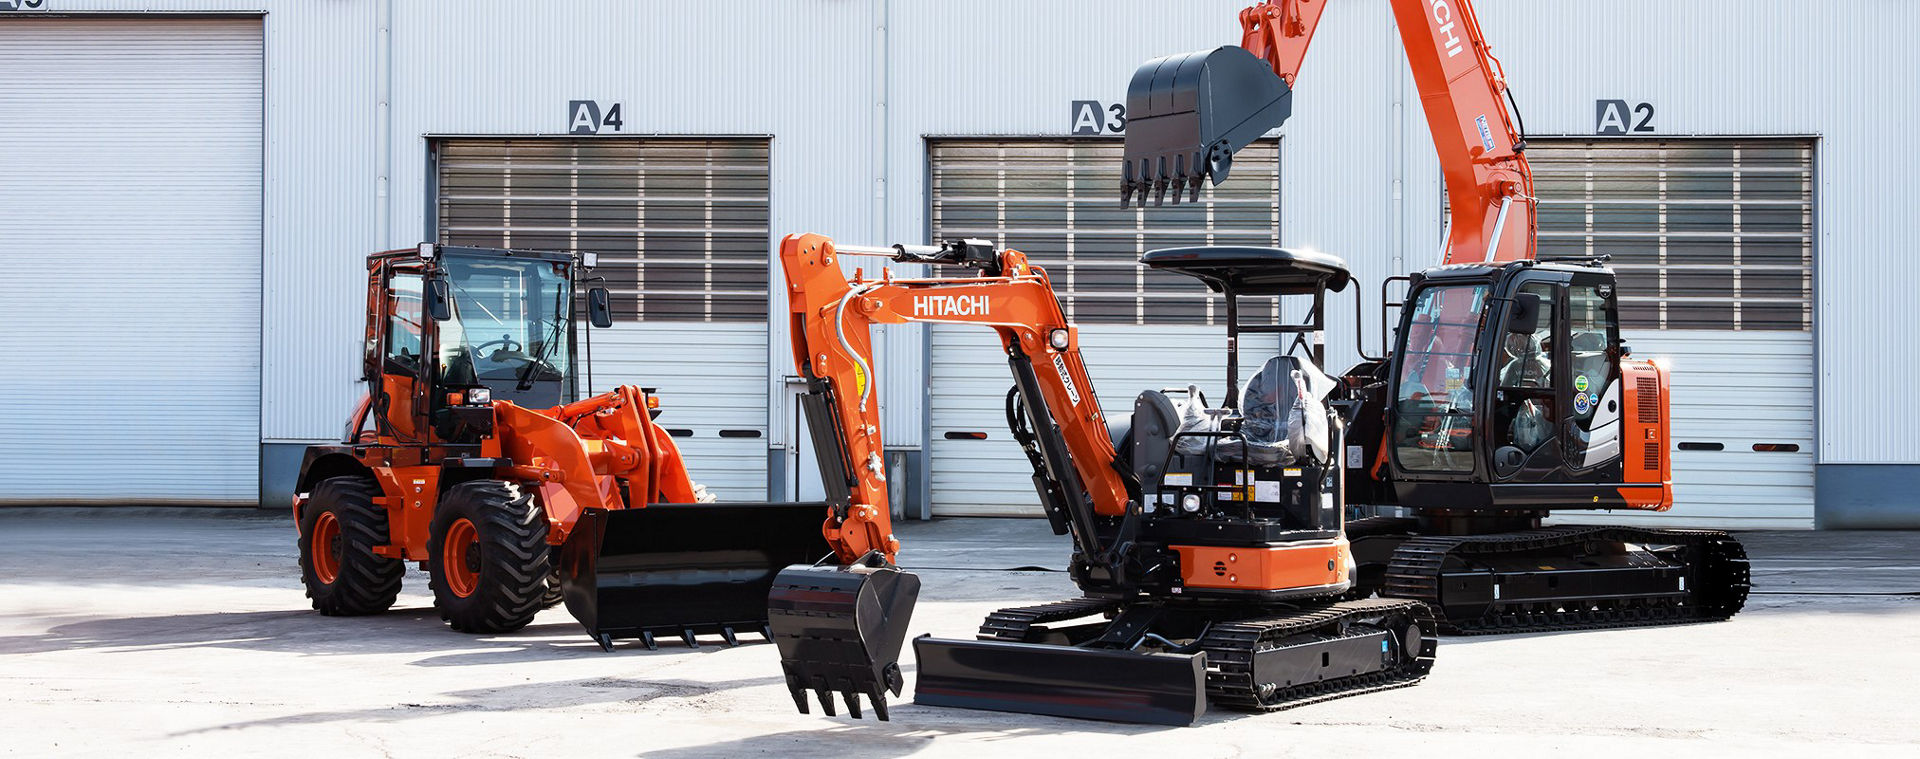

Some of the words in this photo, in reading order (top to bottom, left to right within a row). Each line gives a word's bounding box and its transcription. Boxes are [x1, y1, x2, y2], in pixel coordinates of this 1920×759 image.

[1429, 0, 1463, 57] CHI
[570, 103, 623, 132] A4
[1073, 103, 1126, 133] A3
[1597, 102, 1655, 132] A2
[913, 295, 990, 316] HITACHI
